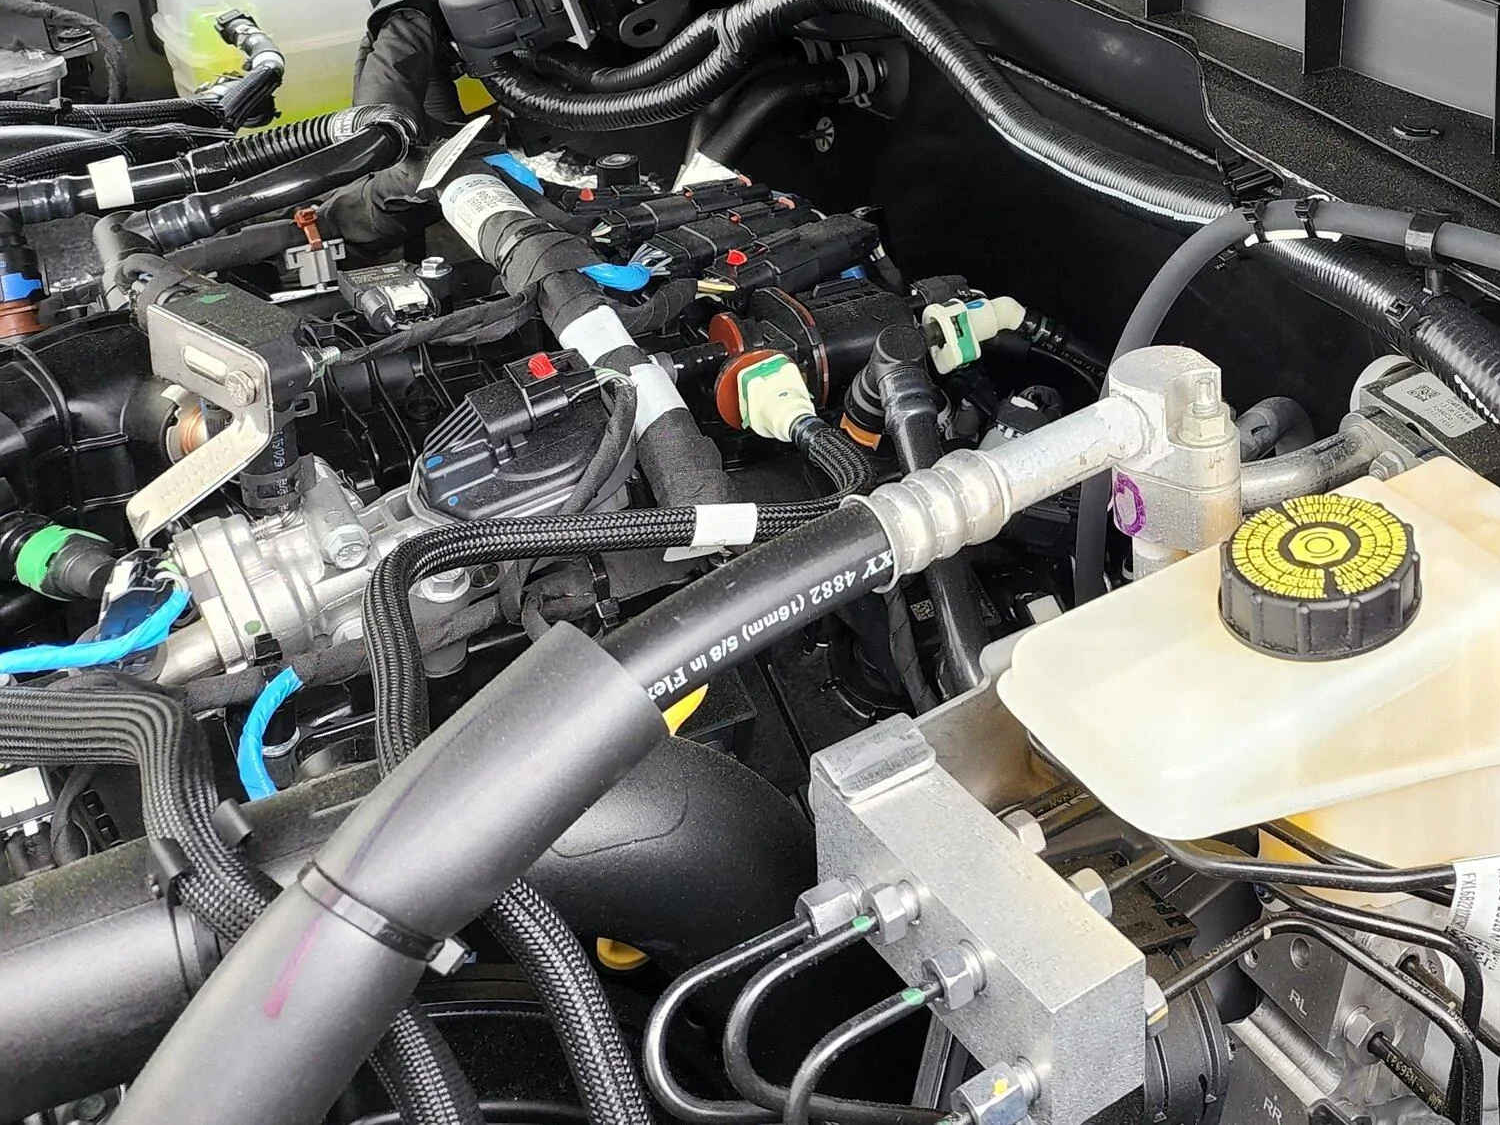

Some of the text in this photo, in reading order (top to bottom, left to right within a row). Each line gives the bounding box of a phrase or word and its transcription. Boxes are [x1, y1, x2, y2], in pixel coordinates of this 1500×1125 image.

[810, 571, 856, 605] 4882
[742, 594, 805, 641] (16mm)
[709, 635, 739, 662] 5/8
[1289, 988, 1308, 1017] RL
[1263, 1097, 1283, 1125] RR
